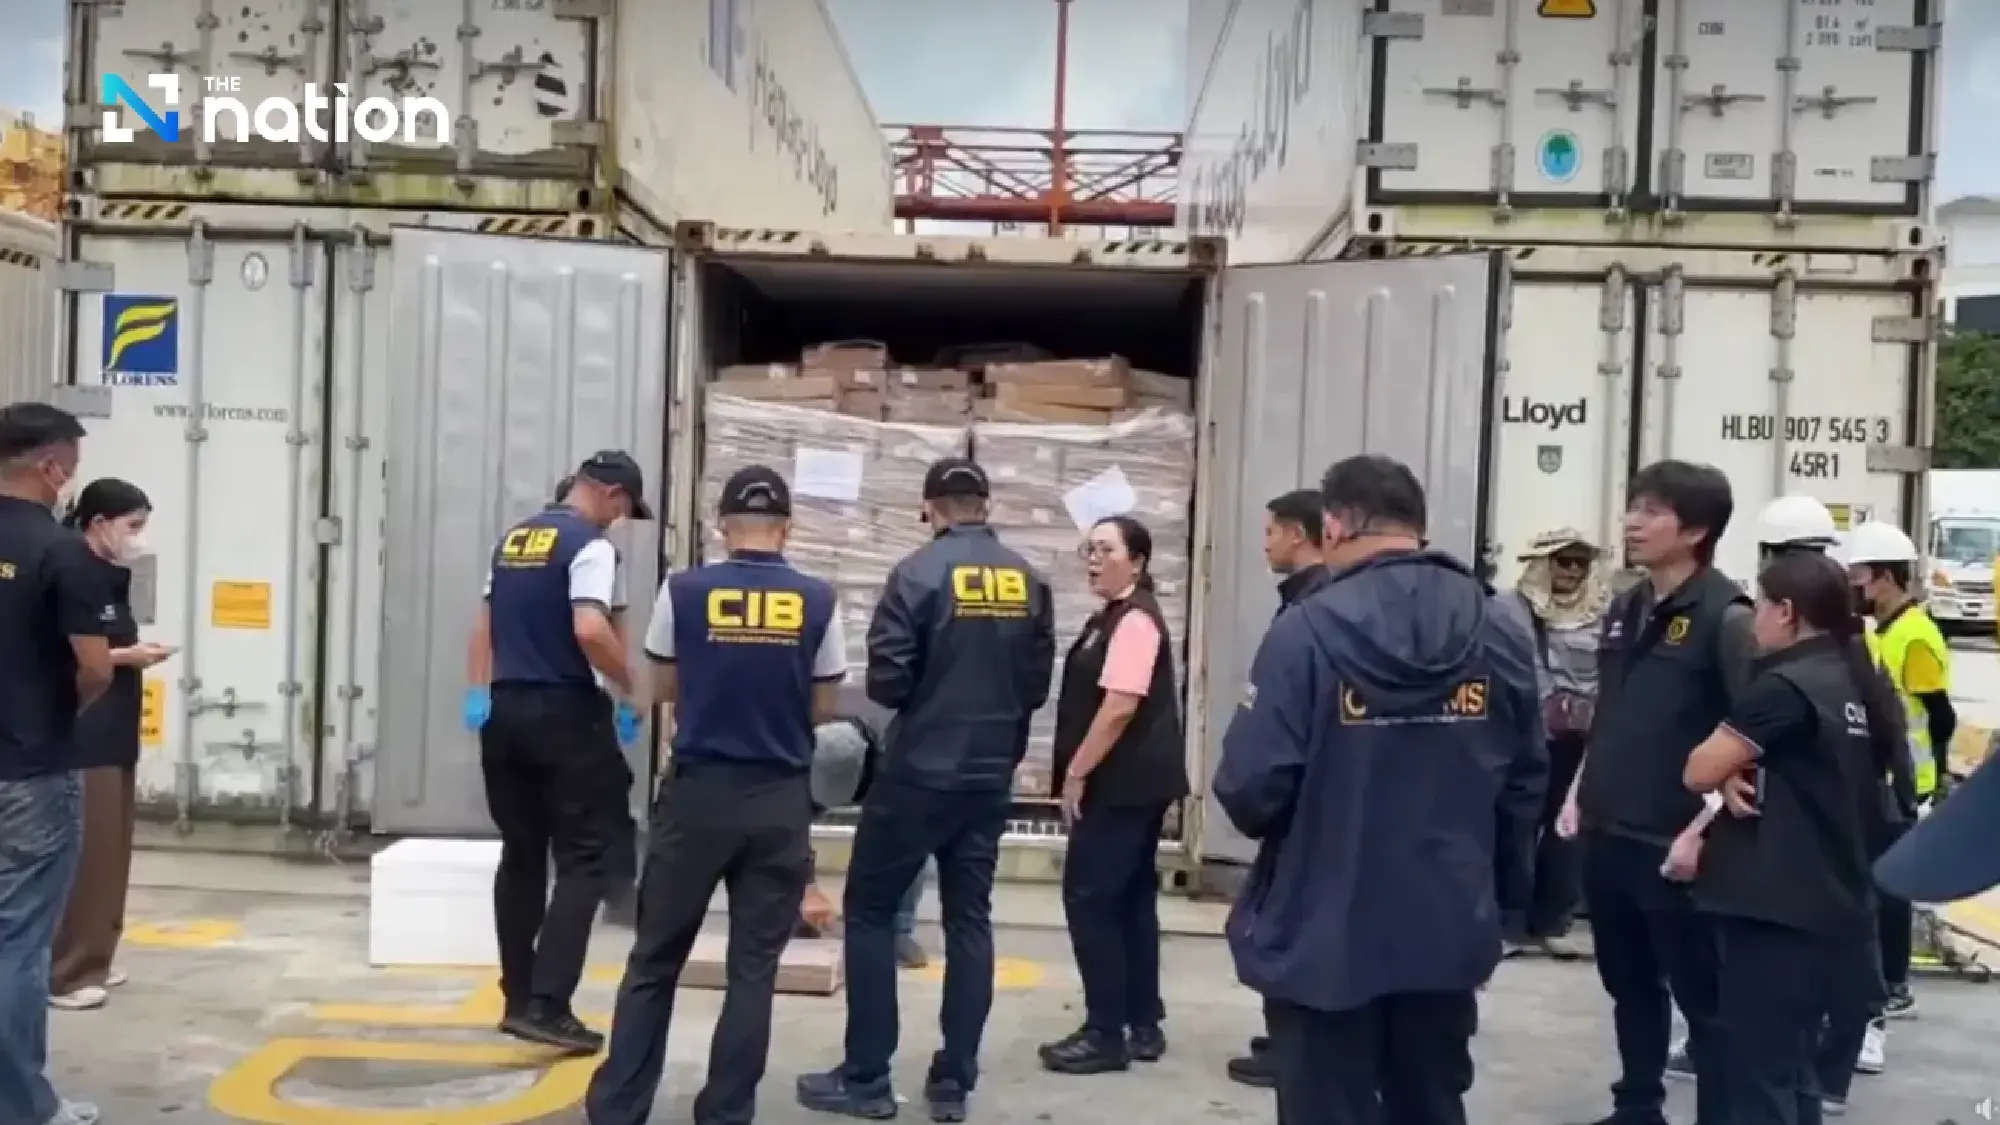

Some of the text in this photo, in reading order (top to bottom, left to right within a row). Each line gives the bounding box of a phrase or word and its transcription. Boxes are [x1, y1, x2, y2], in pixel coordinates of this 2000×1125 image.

[1503, 396, 1586, 430] Lloyd
[1722, 415, 1888, 443] HLBU 907 545 3
[1790, 451, 1839, 478] 45R1
[502, 527, 558, 555] CIB
[952, 567, 1027, 601] CIB
[708, 588, 803, 629] CIB
